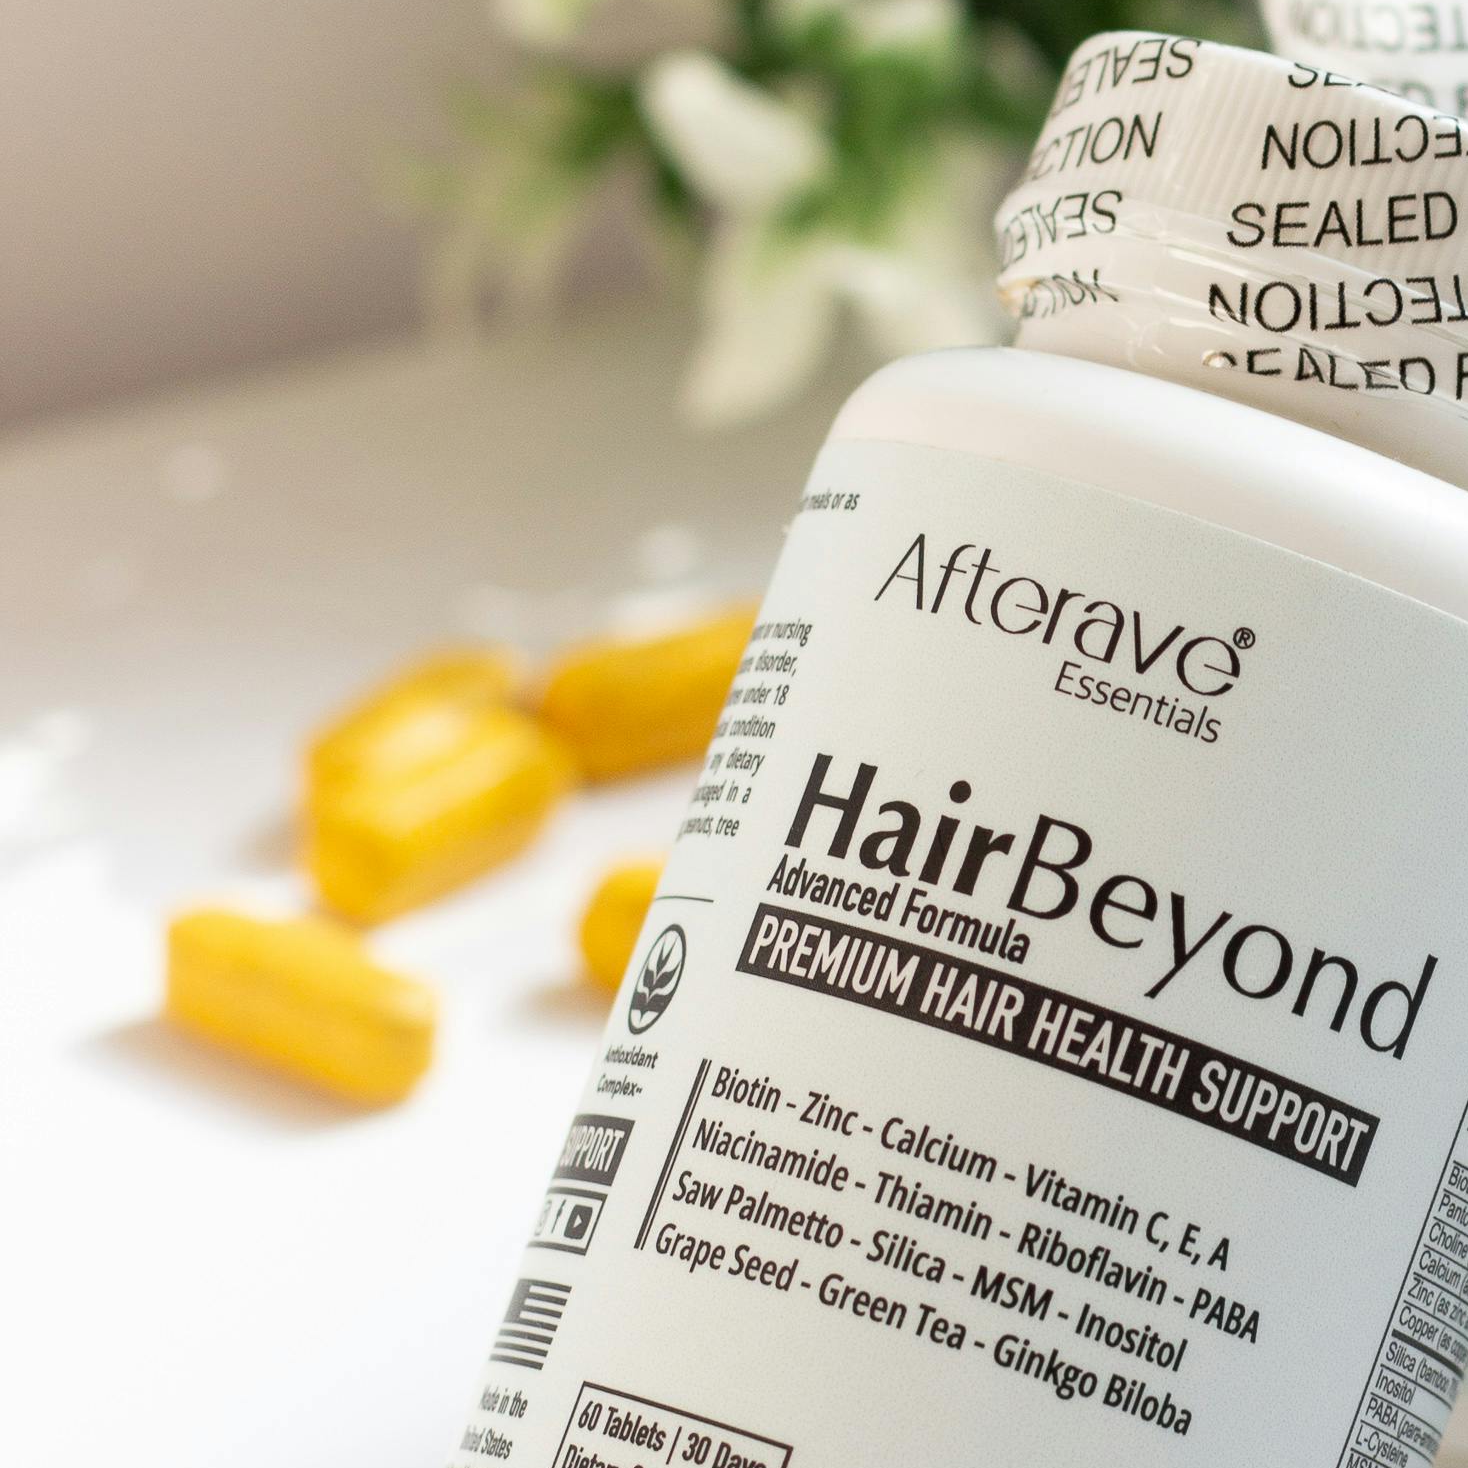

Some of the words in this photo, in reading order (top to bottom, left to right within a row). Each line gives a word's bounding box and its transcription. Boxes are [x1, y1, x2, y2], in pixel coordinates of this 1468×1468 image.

[1226, 191, 1460, 249] SEALED
[844, 493, 860, 511] as
[772, 617, 813, 647] nursing
[773, 684, 790, 706] 18
[1054, 660, 1222, 745] Essentials
[726, 746, 766, 778] dietary
[726, 779, 739, 804] in
[741, 785, 752, 804] a
[715, 813, 740, 837] tree
[766, 853, 900, 923] Advanced
[899, 886, 1031, 966] Formula
[747, 913, 921, 1007] PREMIUM
[919, 961, 1024, 1043] HAIR
[1027, 997, 1191, 1101] HEALTH
[1191, 1058, 1371, 1173] SUPPORT
[711, 1067, 782, 1115] Biotin
[798, 1089, 860, 1138] Zinc
[880, 1116, 998, 1184] Calcium
[1022, 1162, 1141, 1232] Vitamin
[1145, 1211, 1171, 1259] C,
[1175, 1222, 1202, 1271] E,
[1206, 1237, 1231, 1273] A
[692, 1117, 850, 1194] Niacinamide
[871, 1170, 994, 1243] Thiamin
[1019, 1221, 1170, 1308] Riboflavin
[1188, 1287, 1262, 1344] PABA
[671, 1169, 723, 1212] Saw
[723, 1183, 845, 1249] Palmetto
[866, 1228, 947, 1284] Silica
[969, 1264, 1056, 1321] MSM
[1075, 1302, 1191, 1373] Inositol
[1418, 1250, 1463, 1290] Calcium
[1407, 1276, 1436, 1308] Zinc
[654, 1220, 727, 1276] Grape
[727, 1244, 800, 1293] Seed
[818, 1270, 908, 1331] Green
[914, 1303, 969, 1351] Tea
[991, 1332, 1099, 1401] Ginkgo
[1102, 1369, 1195, 1437] Biloba
[1399, 1305, 1441, 1343] Copper
[1385, 1341, 1416, 1375] Silica
[509, 1389, 529, 1419] the
[1374, 1370, 1417, 1406] Inositol
[576, 1399, 603, 1434] 60
[602, 1406, 668, 1455] Tablets
[681, 1431, 711, 1467] 30
[1365, 1397, 1399, 1431] PABA
[1354, 1425, 1409, 1468] L-Cysteine
